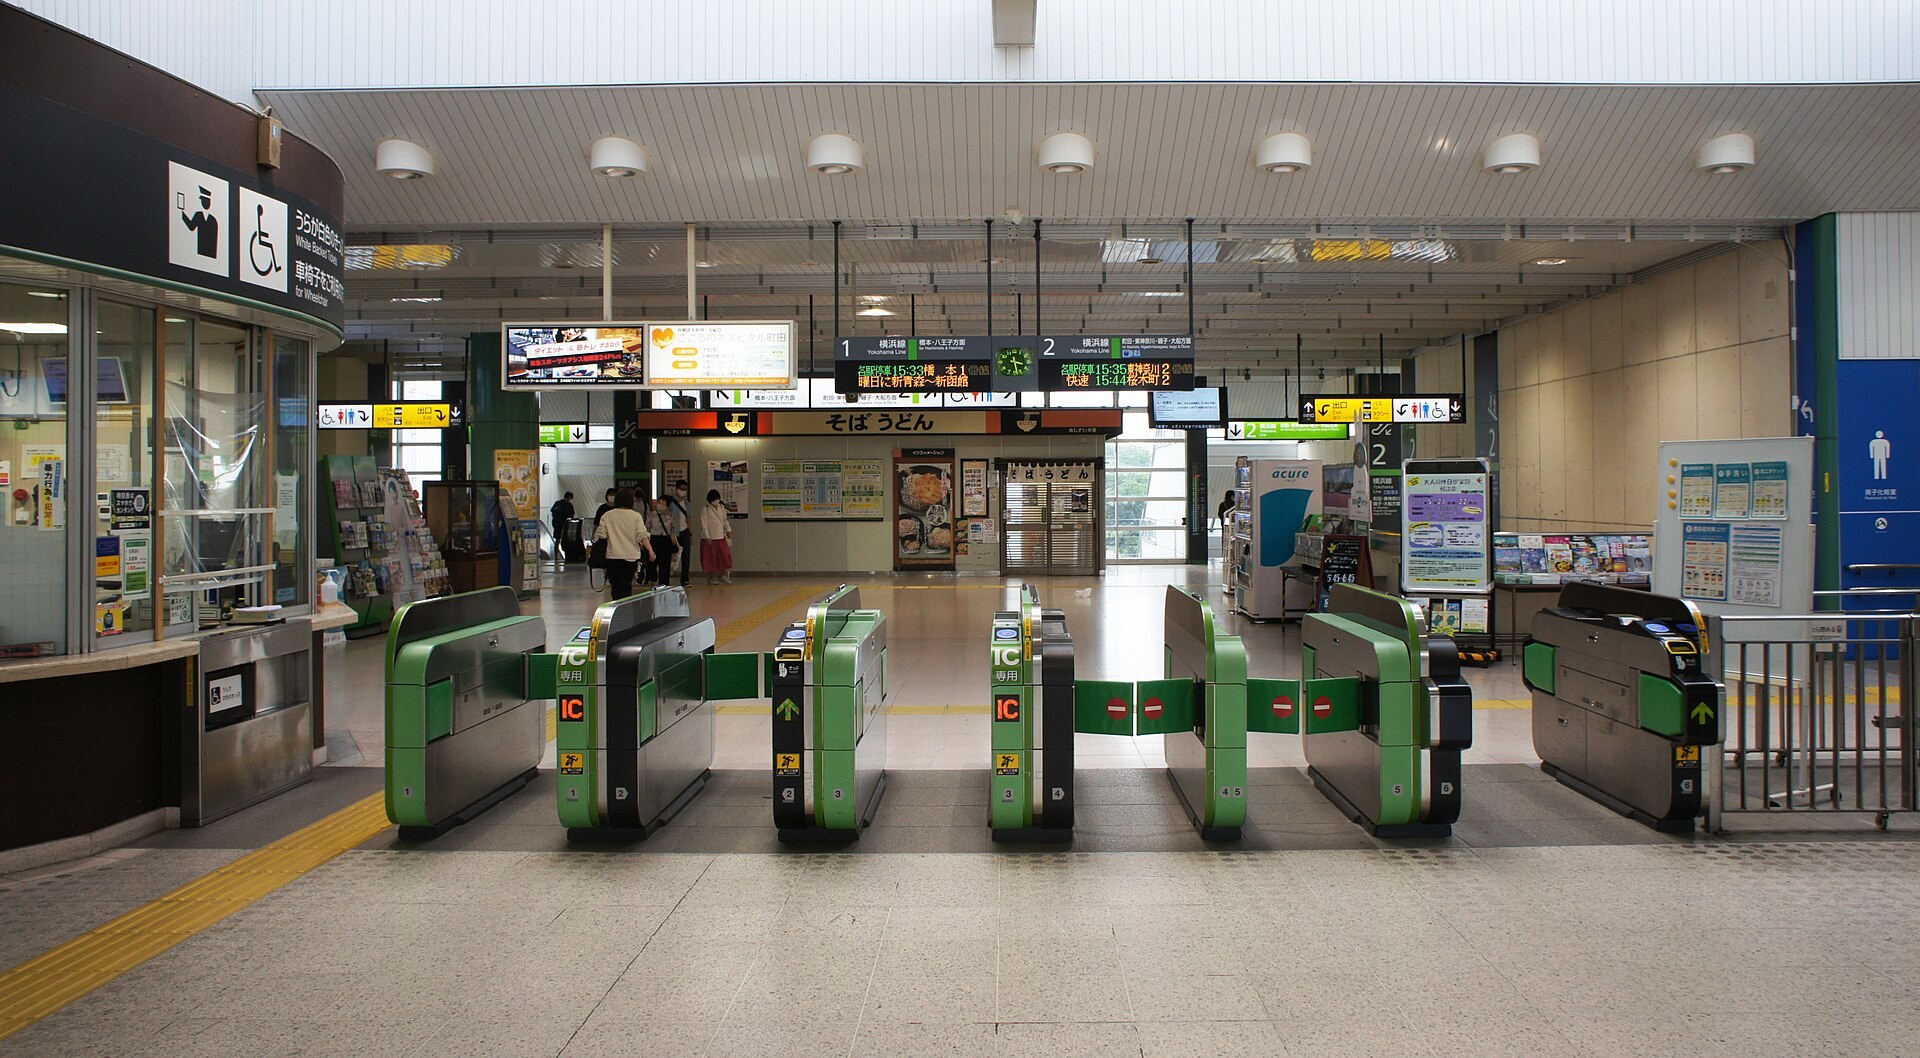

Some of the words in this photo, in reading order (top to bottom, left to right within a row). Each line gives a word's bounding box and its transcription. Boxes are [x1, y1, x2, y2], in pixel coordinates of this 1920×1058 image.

[295, 234, 311, 251] White
[295, 285, 304, 298] for
[304, 287, 328, 307] Wheelchair
[677, 333, 786, 343] こころのホスピタル町田
[1082, 338, 1109, 347] 横浜線
[841, 339, 850, 357] 1
[879, 339, 907, 349] 横浜線
[1043, 338, 1055, 356] 2
[534, 347, 564, 355] ダイエット
[858, 365, 891, 376] 各駅停車
[892, 365, 924, 375] 15:33
[960, 365, 965, 375] 1
[1061, 364, 1095, 376] 各駅停車
[1095, 364, 1127, 375] 15:35
[1126, 364, 1160, 376] 東神奈川
[1161, 364, 1169, 374] 2
[1066, 375, 1089, 387] 快速
[1095, 375, 1127, 386] 15:44
[1126, 375, 1159, 387] 桜木町
[1161, 375, 1169, 386] 2
[1332, 401, 1348, 409] 出口
[825, 413, 871, 432] そば
[878, 413, 934, 432] うどん
[557, 427, 564, 441] 1
[1246, 423, 1257, 438] 2
[1488, 428, 1495, 457] 2
[619, 447, 628, 468] 1
[1372, 443, 1386, 465] 2
[1272, 470, 1309, 479] acure
[1372, 477, 1392, 485] 横浜線
[561, 648, 586, 666] IC
[995, 648, 1020, 666] IC
[561, 670, 582, 681] 専用
[995, 670, 1018, 681] 専用
[561, 698, 583, 719] IC
[996, 698, 1019, 720] IC
[1395, 785, 1401, 793] 5
[1443, 784, 1449, 792] 6
[1685, 780, 1690, 789] 6
[405, 788, 410, 796] 1
[571, 789, 575, 797] 1
[618, 789, 623, 797] 2
[1222, 788, 1228, 796] 4
[1235, 788, 1241, 796] 5
